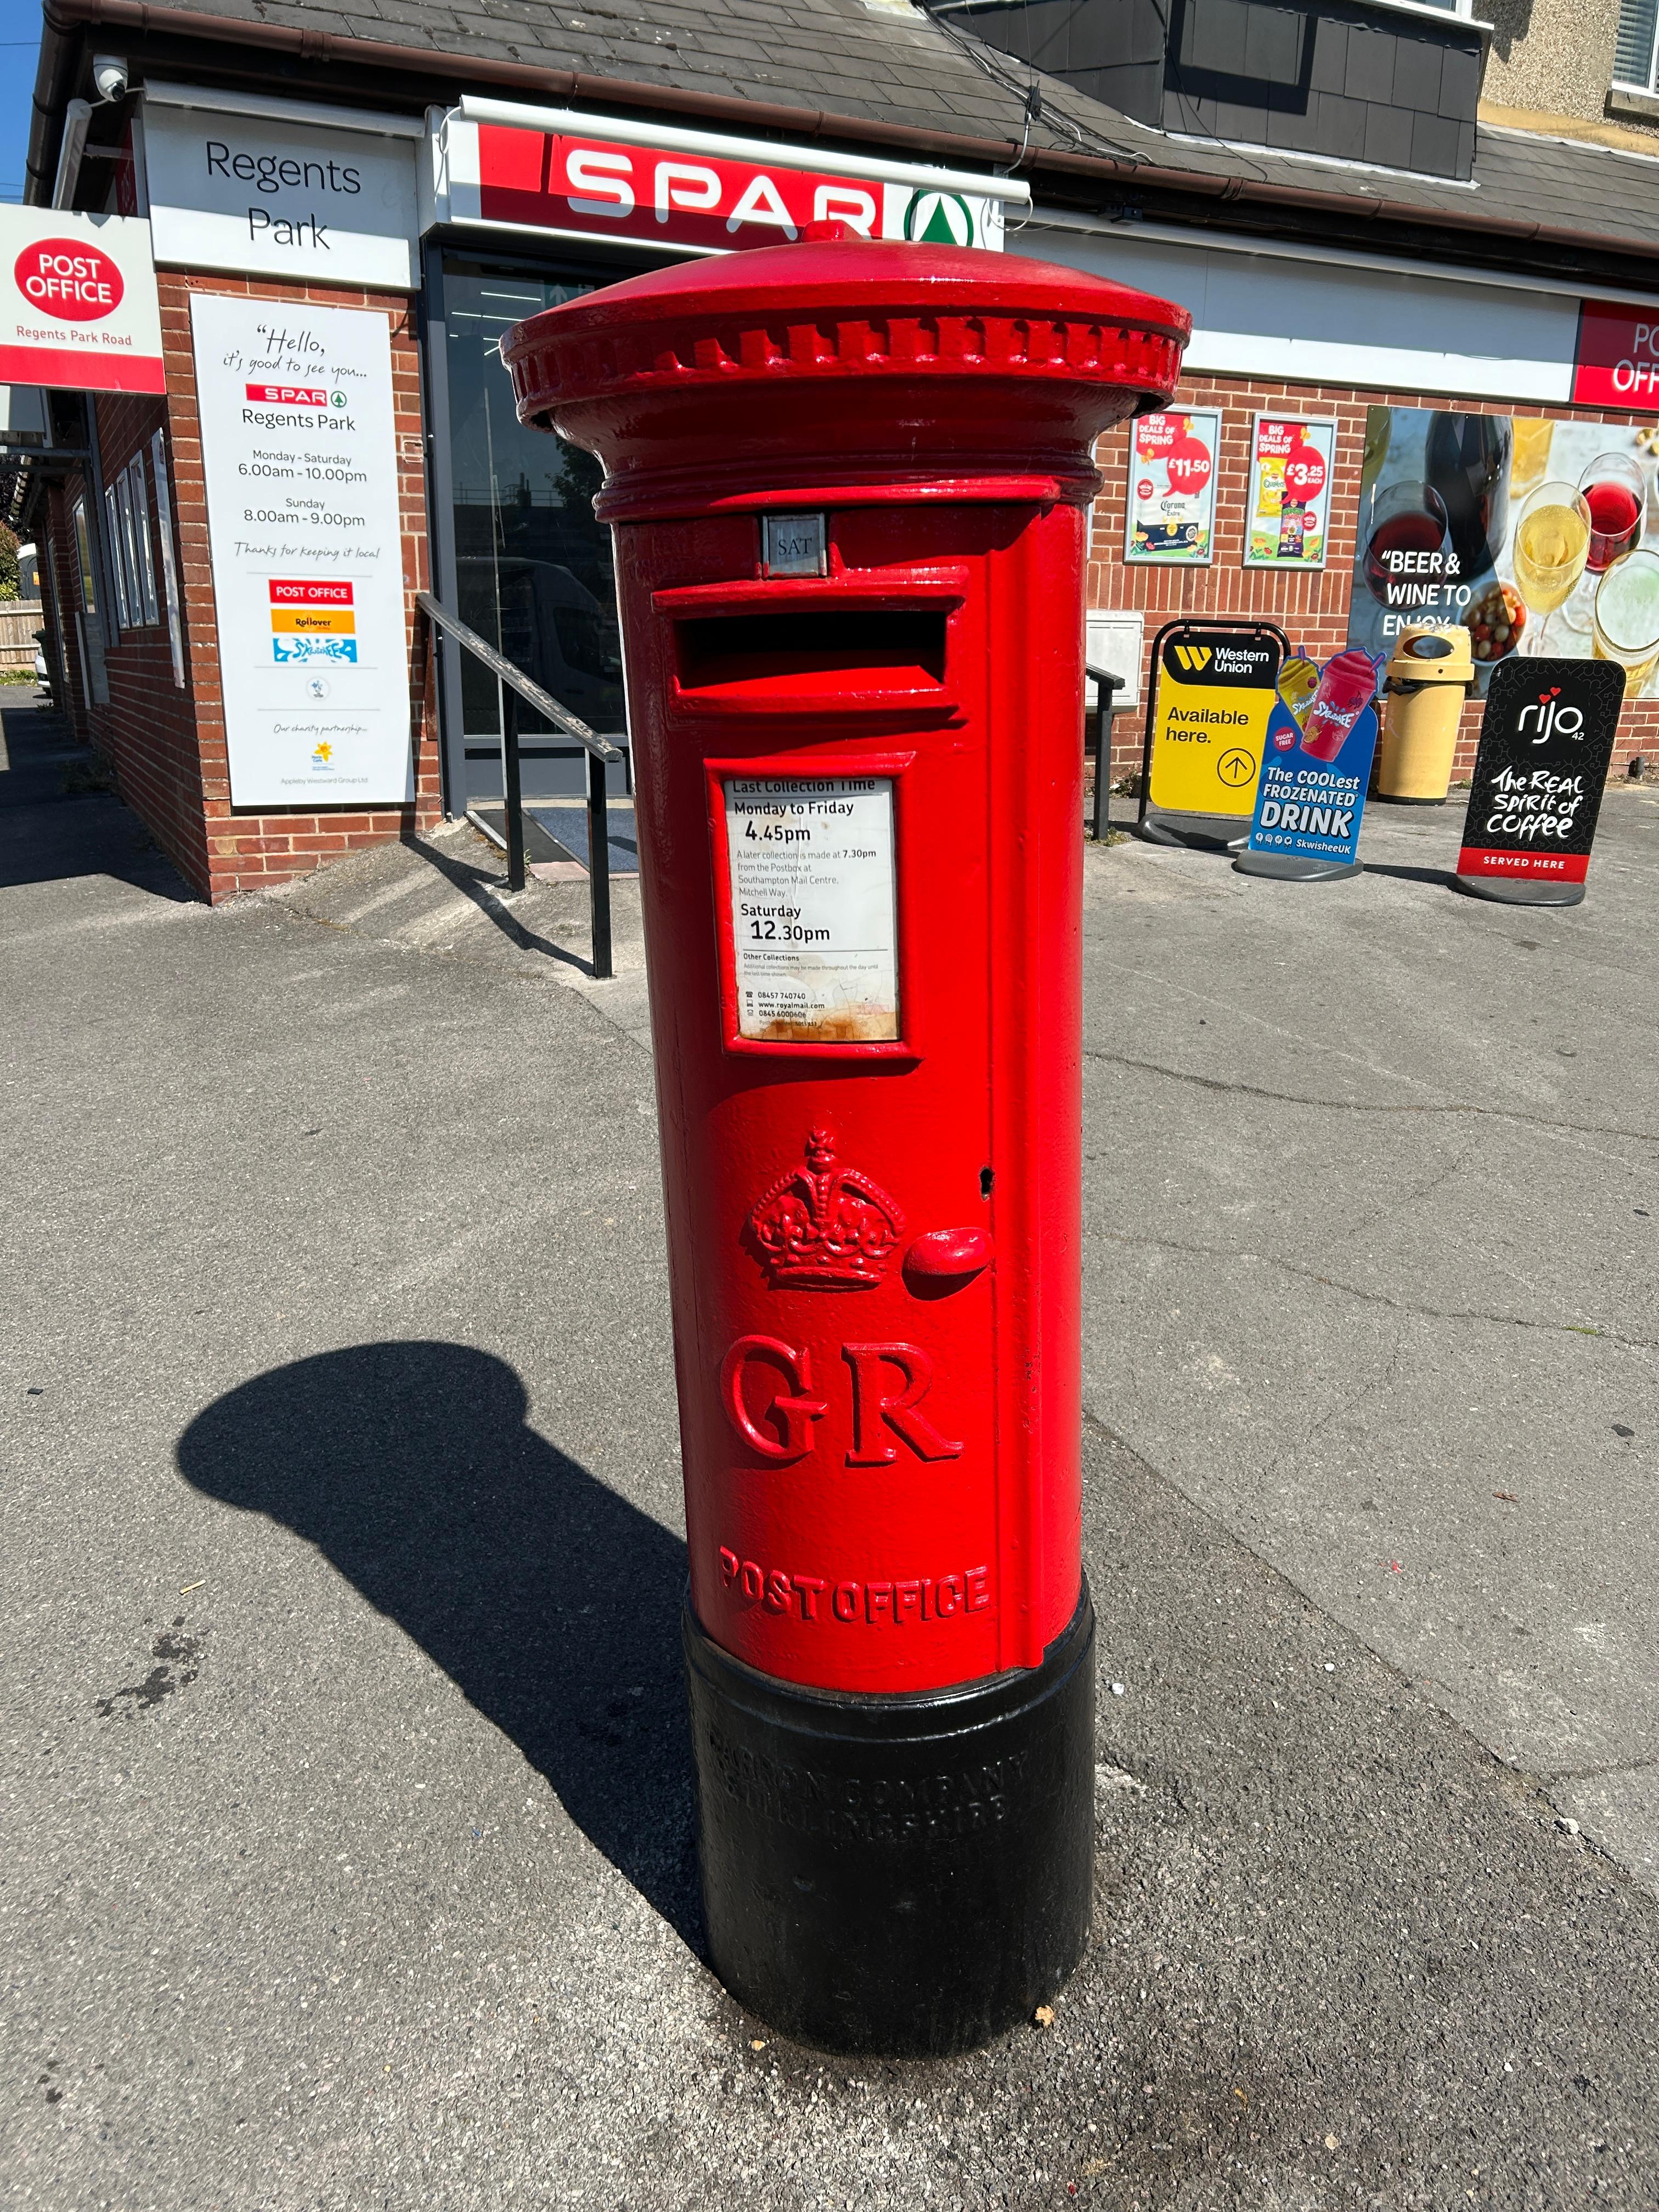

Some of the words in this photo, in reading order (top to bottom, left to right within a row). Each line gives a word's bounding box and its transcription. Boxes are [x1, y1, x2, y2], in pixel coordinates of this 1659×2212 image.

[206, 141, 360, 194] Regents
[566, 149, 876, 241] SPAR
[249, 207, 330, 249] Park
[38, 253, 100, 279] POST
[26, 276, 112, 303] OFFICE
[16, 326, 66, 340] Regents
[71, 330, 98, 343] Park
[103, 333, 132, 346] Road
[248, 356, 281, 375] good
[286, 358, 300, 371] to
[304, 364, 325, 377] see
[264, 388, 326, 404] SPAR
[242, 409, 313, 429] Regents
[318, 415, 356, 431] Park
[1149, 415, 1166, 426] BIG
[1139, 425, 1164, 435] DEALS
[1165, 426, 1176, 435] OF
[1268, 425, 1284, 436] BIG
[1139, 435, 1173, 445] SPRING
[1259, 435, 1281, 444] DEALS
[1283, 436, 1293, 444] OF
[1259, 443, 1291, 454] SPRING
[253, 450, 295, 463] Monday
[304, 453, 352, 467] Saturday
[239, 464, 294, 478] 6.00am
[306, 467, 367, 483] 10.00pm
[1168, 458, 1210, 477] £11.50
[1286, 463, 1323, 486] £3.25
[286, 498, 325, 511] Sunday
[1161, 500, 1186, 511] Corona
[244, 510, 299, 523] 8.00am
[311, 513, 365, 528] 9.00pm
[234, 541, 276, 557] Thanks
[280, 544, 298, 557] for
[300, 545, 340, 561] keeping
[343, 548, 353, 557] it
[356, 547, 380, 558] local
[778, 537, 812, 556] SAT
[1445, 553, 1460, 574] &
[275, 586, 306, 597] POST
[308, 587, 348, 599] OFFICE
[1387, 583, 1441, 605] WINE
[1443, 585, 1471, 606] TO
[296, 617, 331, 628] Rollover
[1216, 647, 1269, 662] Western
[1214, 660, 1252, 674] Union
[1167, 707, 1249, 725] Available
[1518, 699, 1583, 744] rijo
[274, 724, 289, 733] Our
[291, 724, 319, 735] charity
[1166, 727, 1211, 744] here.
[1275, 732, 1294, 742] SUGAR
[1571, 732, 1584, 741] 42
[1279, 738, 1292, 747] FREE
[1267, 766, 1294, 783] The
[1491, 766, 1531, 792] The
[733, 780, 761, 793] Last
[765, 780, 834, 793] Collection
[841, 780, 875, 791] Time
[1263, 783, 1356, 807] FROZENATED
[735, 802, 787, 817] Monday
[791, 803, 804, 814] to
[809, 802, 854, 816] Friday
[1559, 795, 1583, 816] of
[1260, 800, 1355, 838] DRINK
[745, 820, 810, 844] 4.45pm
[737, 850, 743, 859] A
[743, 850, 760, 859] later
[762, 851, 798, 859] collection
[800, 851, 806, 859] is
[808, 850, 831, 859] made
[842, 849, 876, 860] 7.30pm
[1296, 838, 1352, 854] SkwisheeUK
[738, 862, 755, 871] from
[758, 863, 769, 872] the
[771, 862, 802, 872] Postbox
[1483, 856, 1529, 867] SERVED
[1533, 859, 1565, 870] HERE
[738, 875, 789, 885] Southampton
[791, 876, 808, 885] Mail
[739, 888, 768, 896] Mitchell
[741, 904, 801, 919] Saturday
[751, 920, 830, 944] 12.30pm
[758, 1001, 825, 1009] www.royalmail.com
[720, 1334, 965, 1467] GR
[719, 1544, 823, 1621] POST
[831, 1564, 991, 1624] OFFICE
